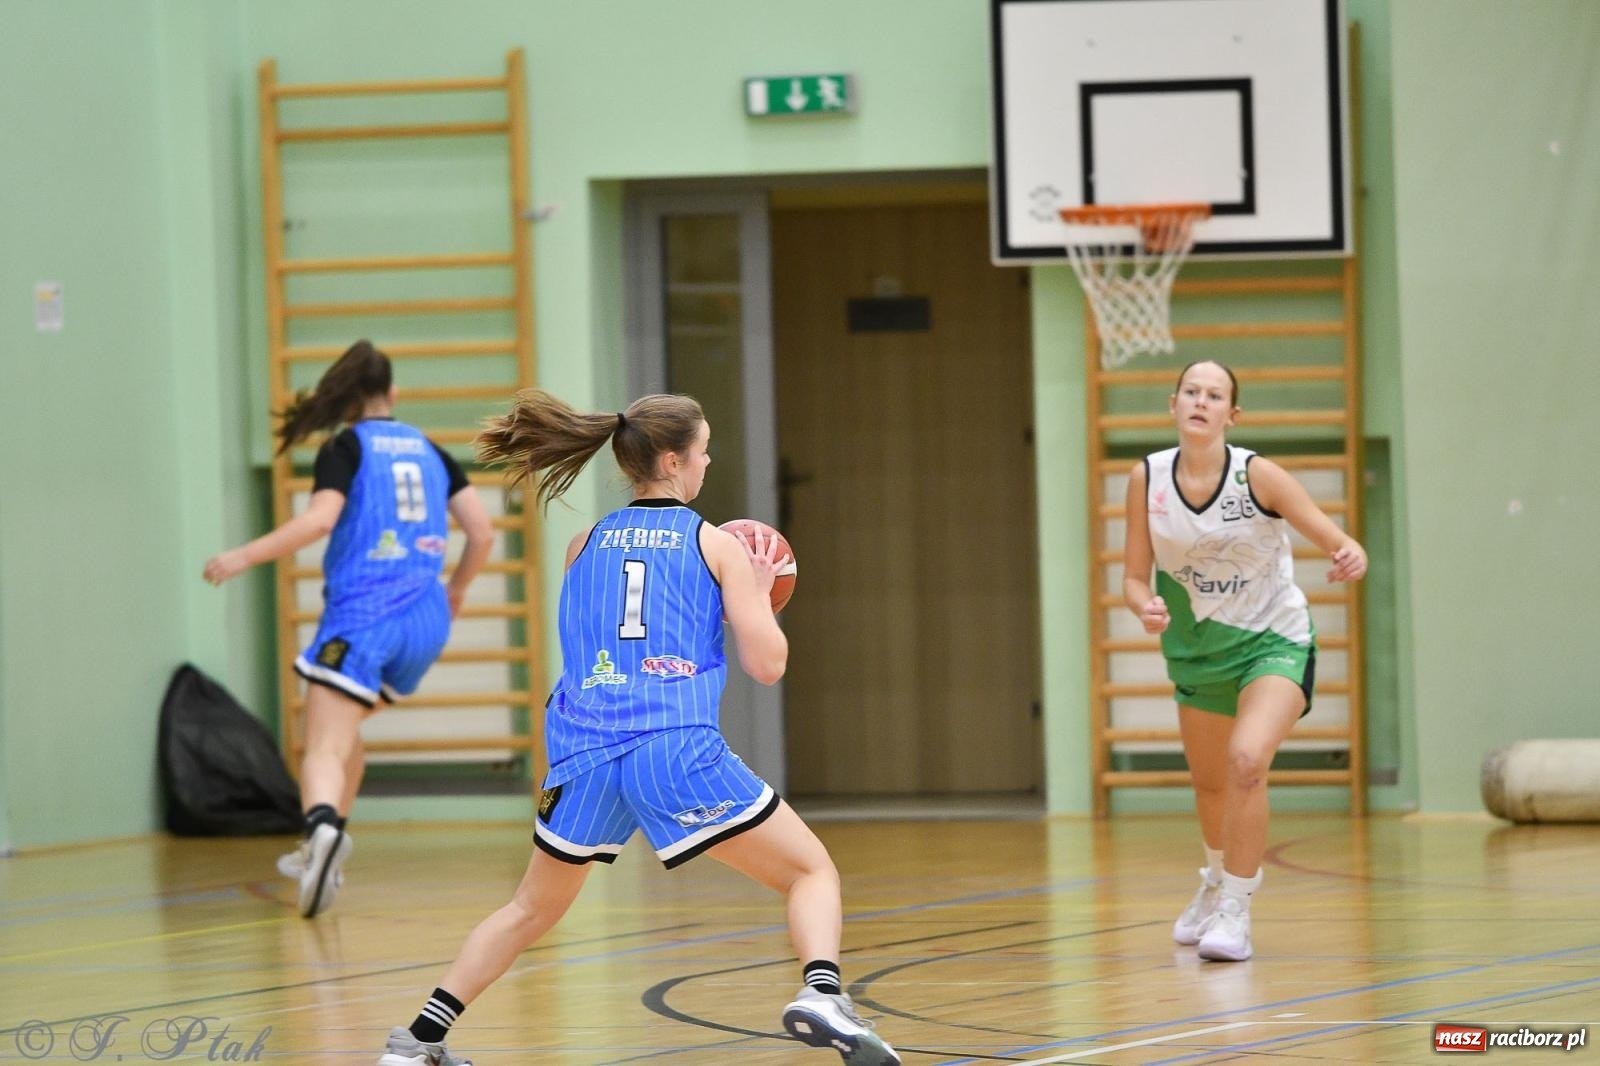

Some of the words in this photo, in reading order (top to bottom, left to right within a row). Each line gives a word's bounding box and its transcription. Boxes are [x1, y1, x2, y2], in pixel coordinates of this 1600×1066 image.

[392, 461, 427, 522] 0
[599, 527, 684, 553] ZIĘBICE
[619, 559, 646, 640] 1
